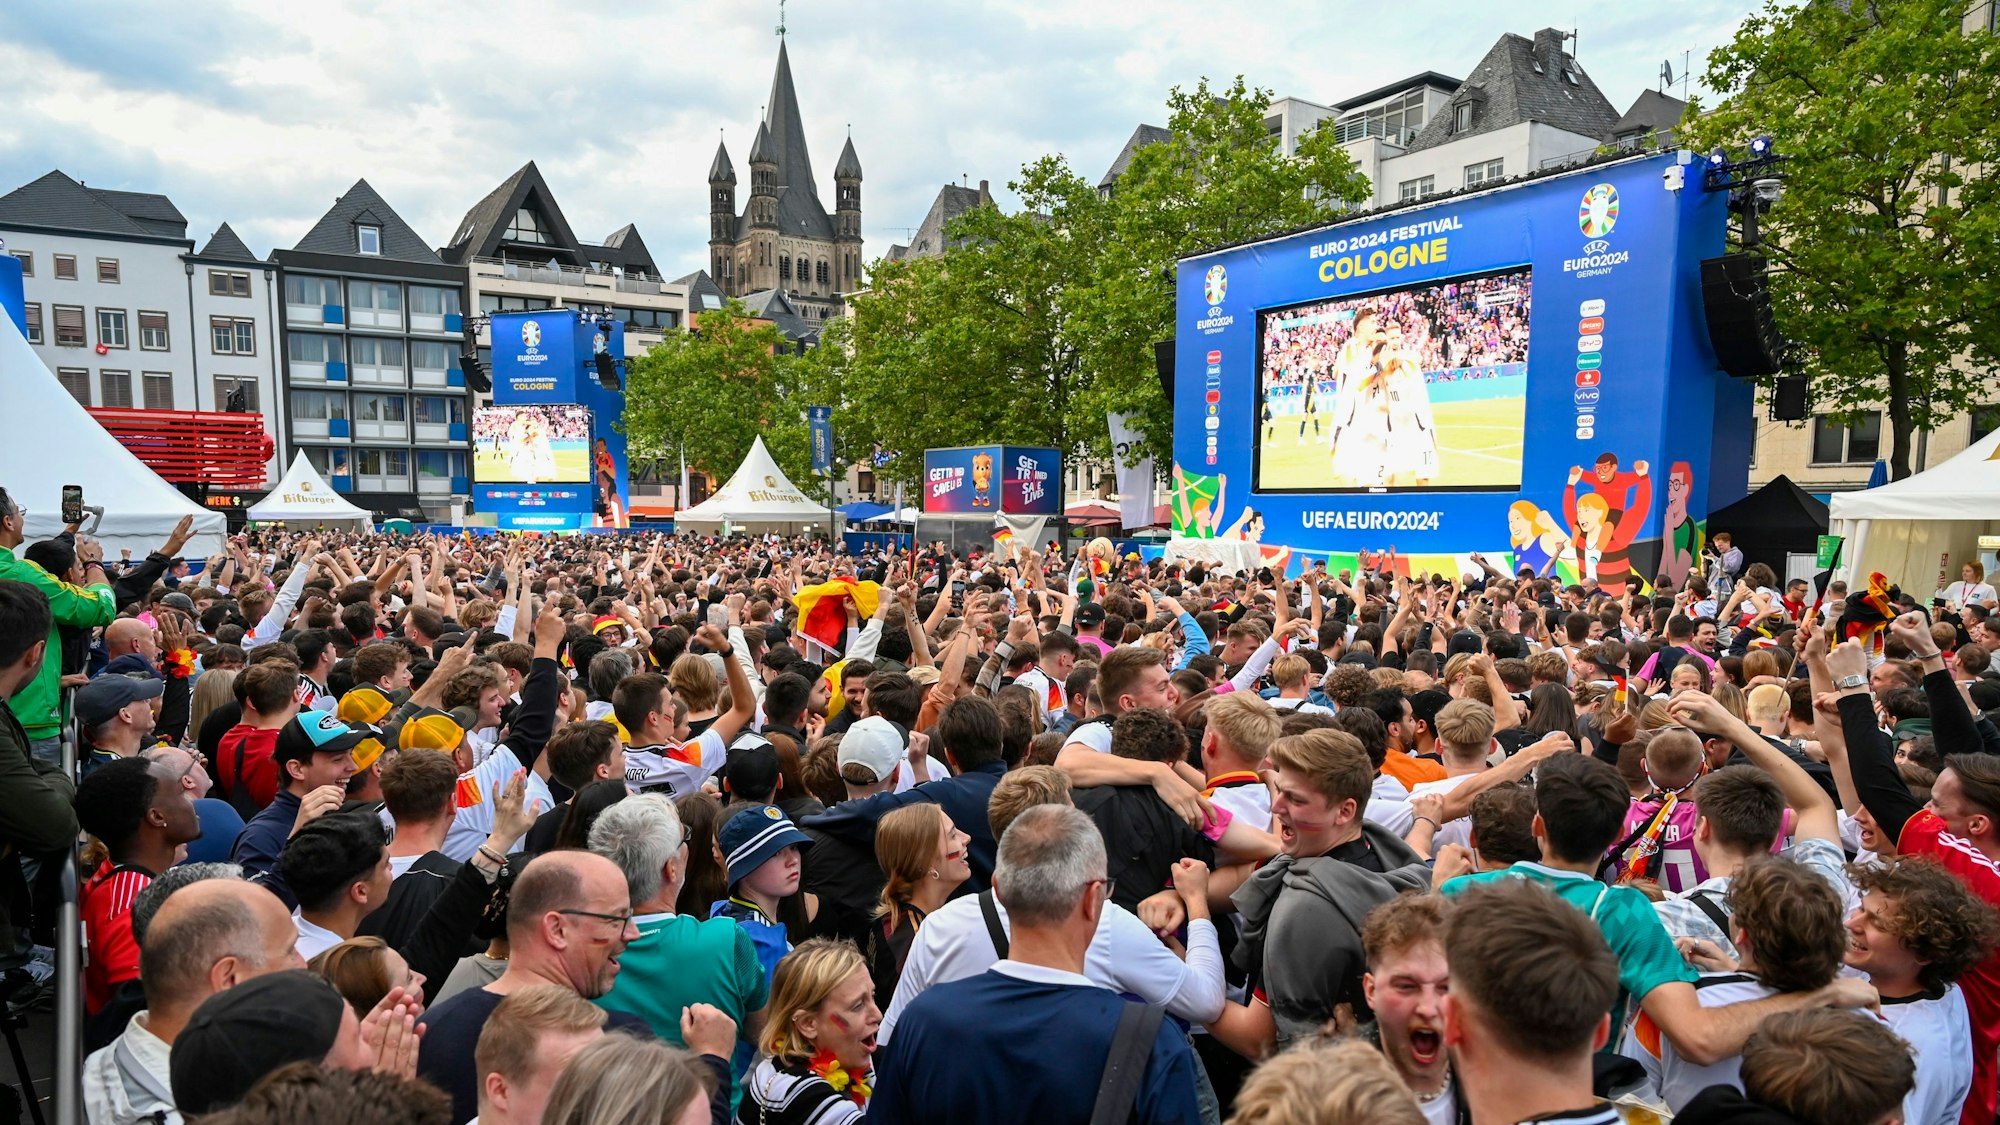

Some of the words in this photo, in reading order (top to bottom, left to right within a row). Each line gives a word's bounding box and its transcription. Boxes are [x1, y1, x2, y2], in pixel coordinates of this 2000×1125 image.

[1309, 239, 1348, 259] EURO
[1350, 230, 1388, 251] 2024
[1390, 215, 1463, 241] FESTIVAL
[1584, 241, 1608, 253] UEFA
[1318, 237, 1448, 283] COLOGNE
[1563, 250, 1629, 272] EURO2024
[1576, 266, 1613, 279] GERMANY
[1196, 315, 1233, 330] EURO2024
[1204, 327, 1225, 335] GERMANY
[517, 354, 548, 362] EURO2024
[1575, 391, 1599, 400] vivo
[1018, 455, 1038, 470] GET
[930, 467, 945, 482] GET
[283, 492, 336, 505] Bitburger
[748, 489, 804, 504] Bitburger
[1024, 488, 1045, 506] LIVES
